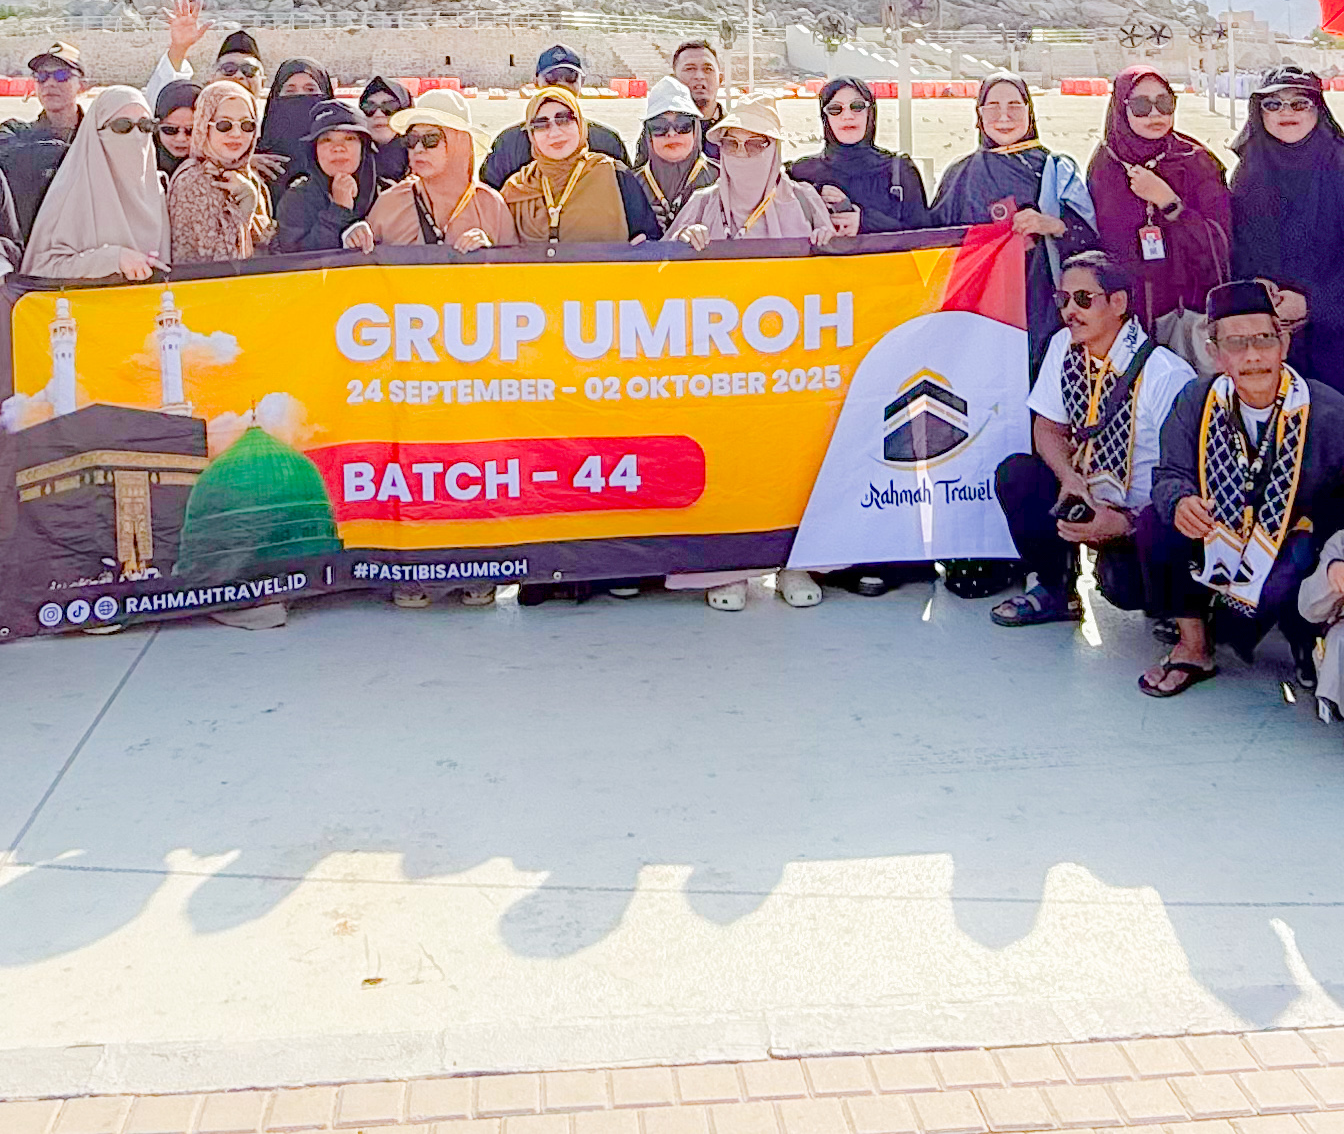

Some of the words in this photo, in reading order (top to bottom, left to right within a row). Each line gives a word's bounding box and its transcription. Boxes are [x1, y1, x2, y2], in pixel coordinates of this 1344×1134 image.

[335, 301, 546, 362] GRUP
[563, 291, 854, 359] UMROH
[346, 378, 384, 404] 24
[388, 378, 556, 404] SEPTEMBER
[584, 376, 622, 401] 02
[626, 371, 766, 400] OKTOBER
[771, 364, 842, 393] 2025
[343, 458, 521, 503] BATCH
[572, 454, 642, 493] 44
[860, 477, 932, 510] Rahmah
[353, 558, 528, 581] #PASTIBISAUMROH
[125, 572, 307, 614] RAHMAHTRAVEL.ID
